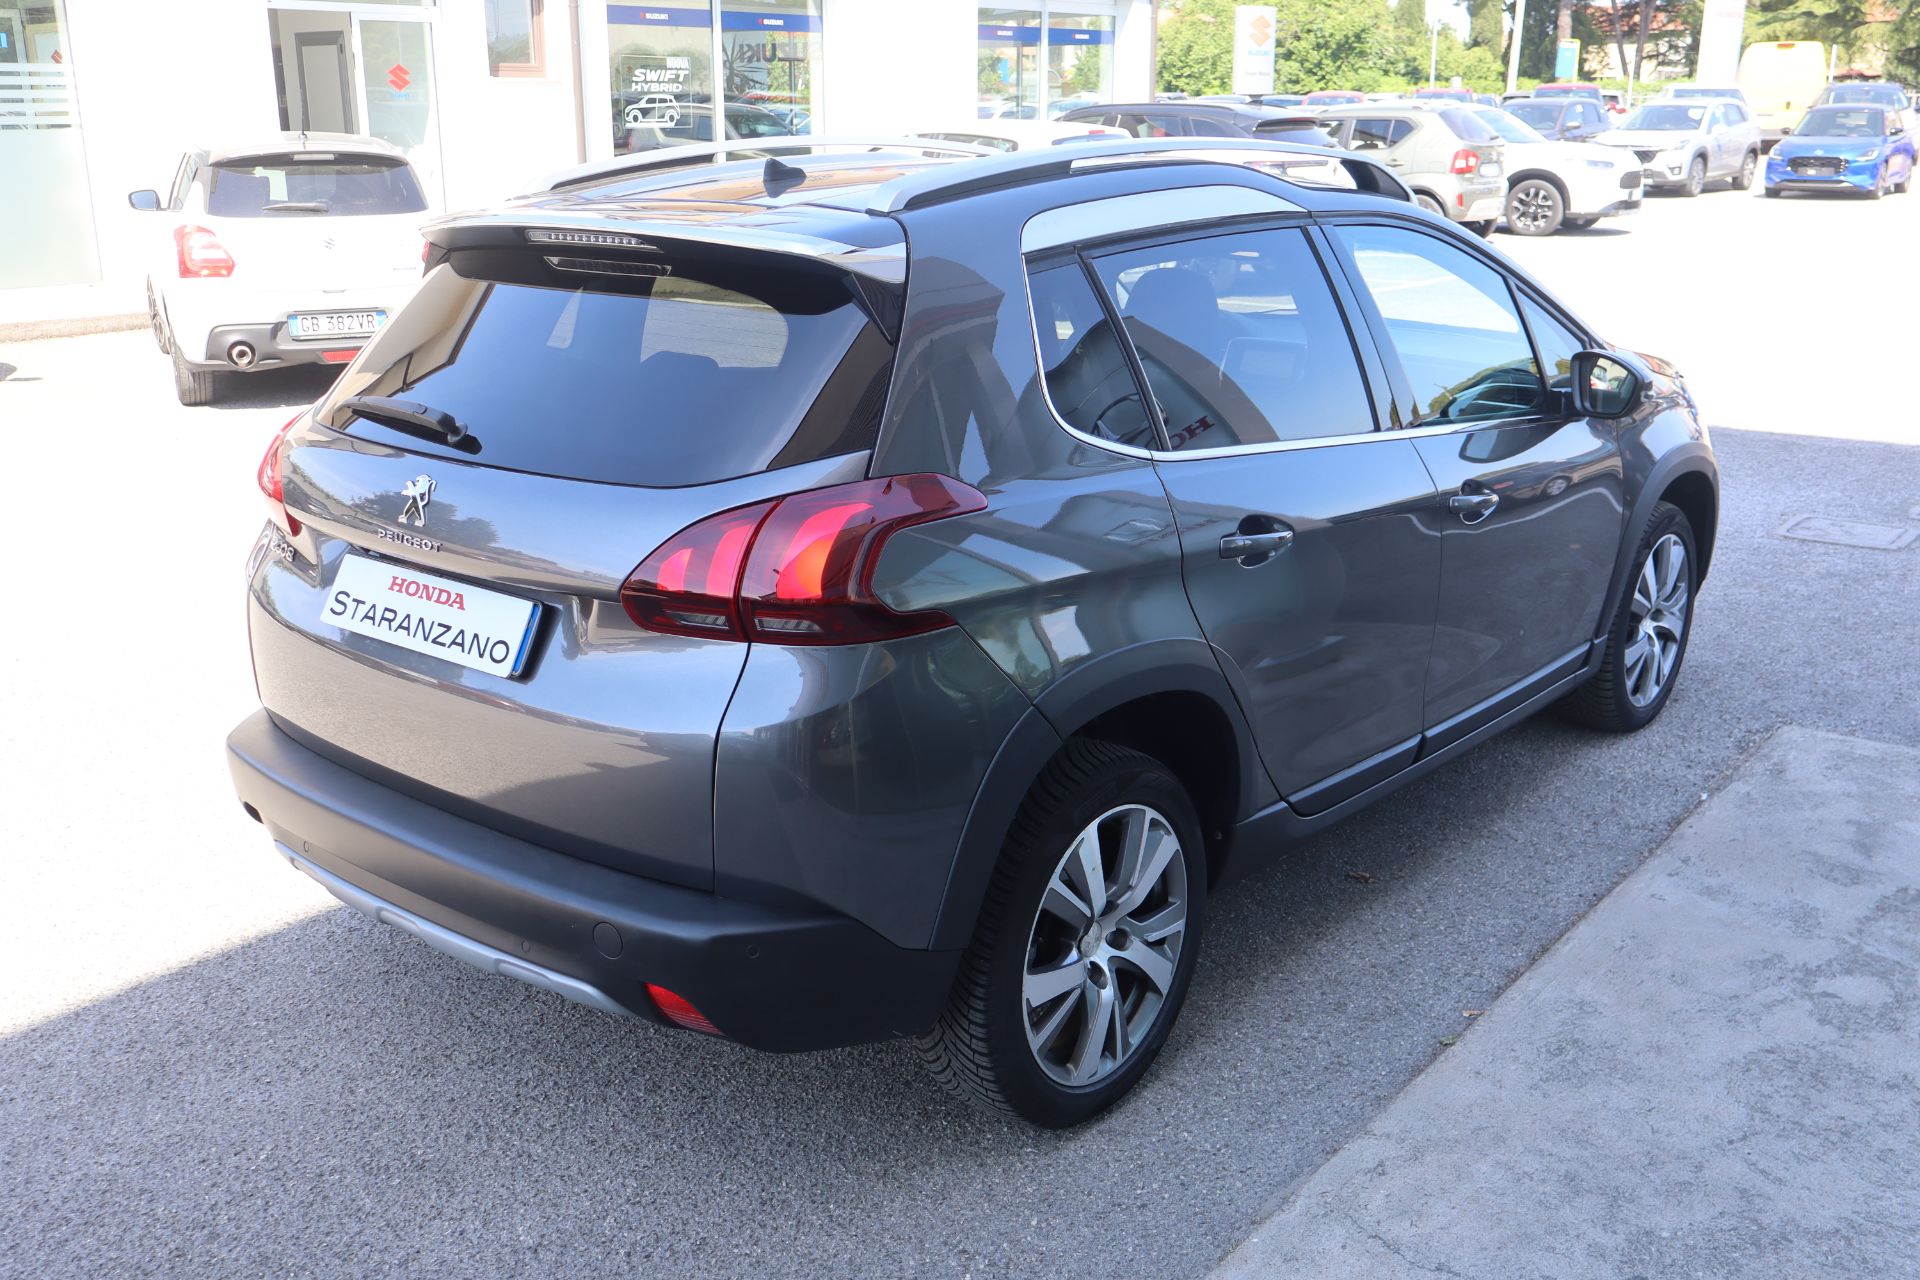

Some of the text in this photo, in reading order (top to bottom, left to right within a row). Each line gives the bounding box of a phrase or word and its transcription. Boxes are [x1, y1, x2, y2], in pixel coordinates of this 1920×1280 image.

[632, 69, 690, 82] SWIFT
[631, 83, 683, 92] HYBRID
[301, 314, 375, 332] GB 382VR
[377, 528, 442, 553] PEUGEOT
[388, 575, 466, 611] HONDA
[329, 590, 510, 664] STARANZANO
